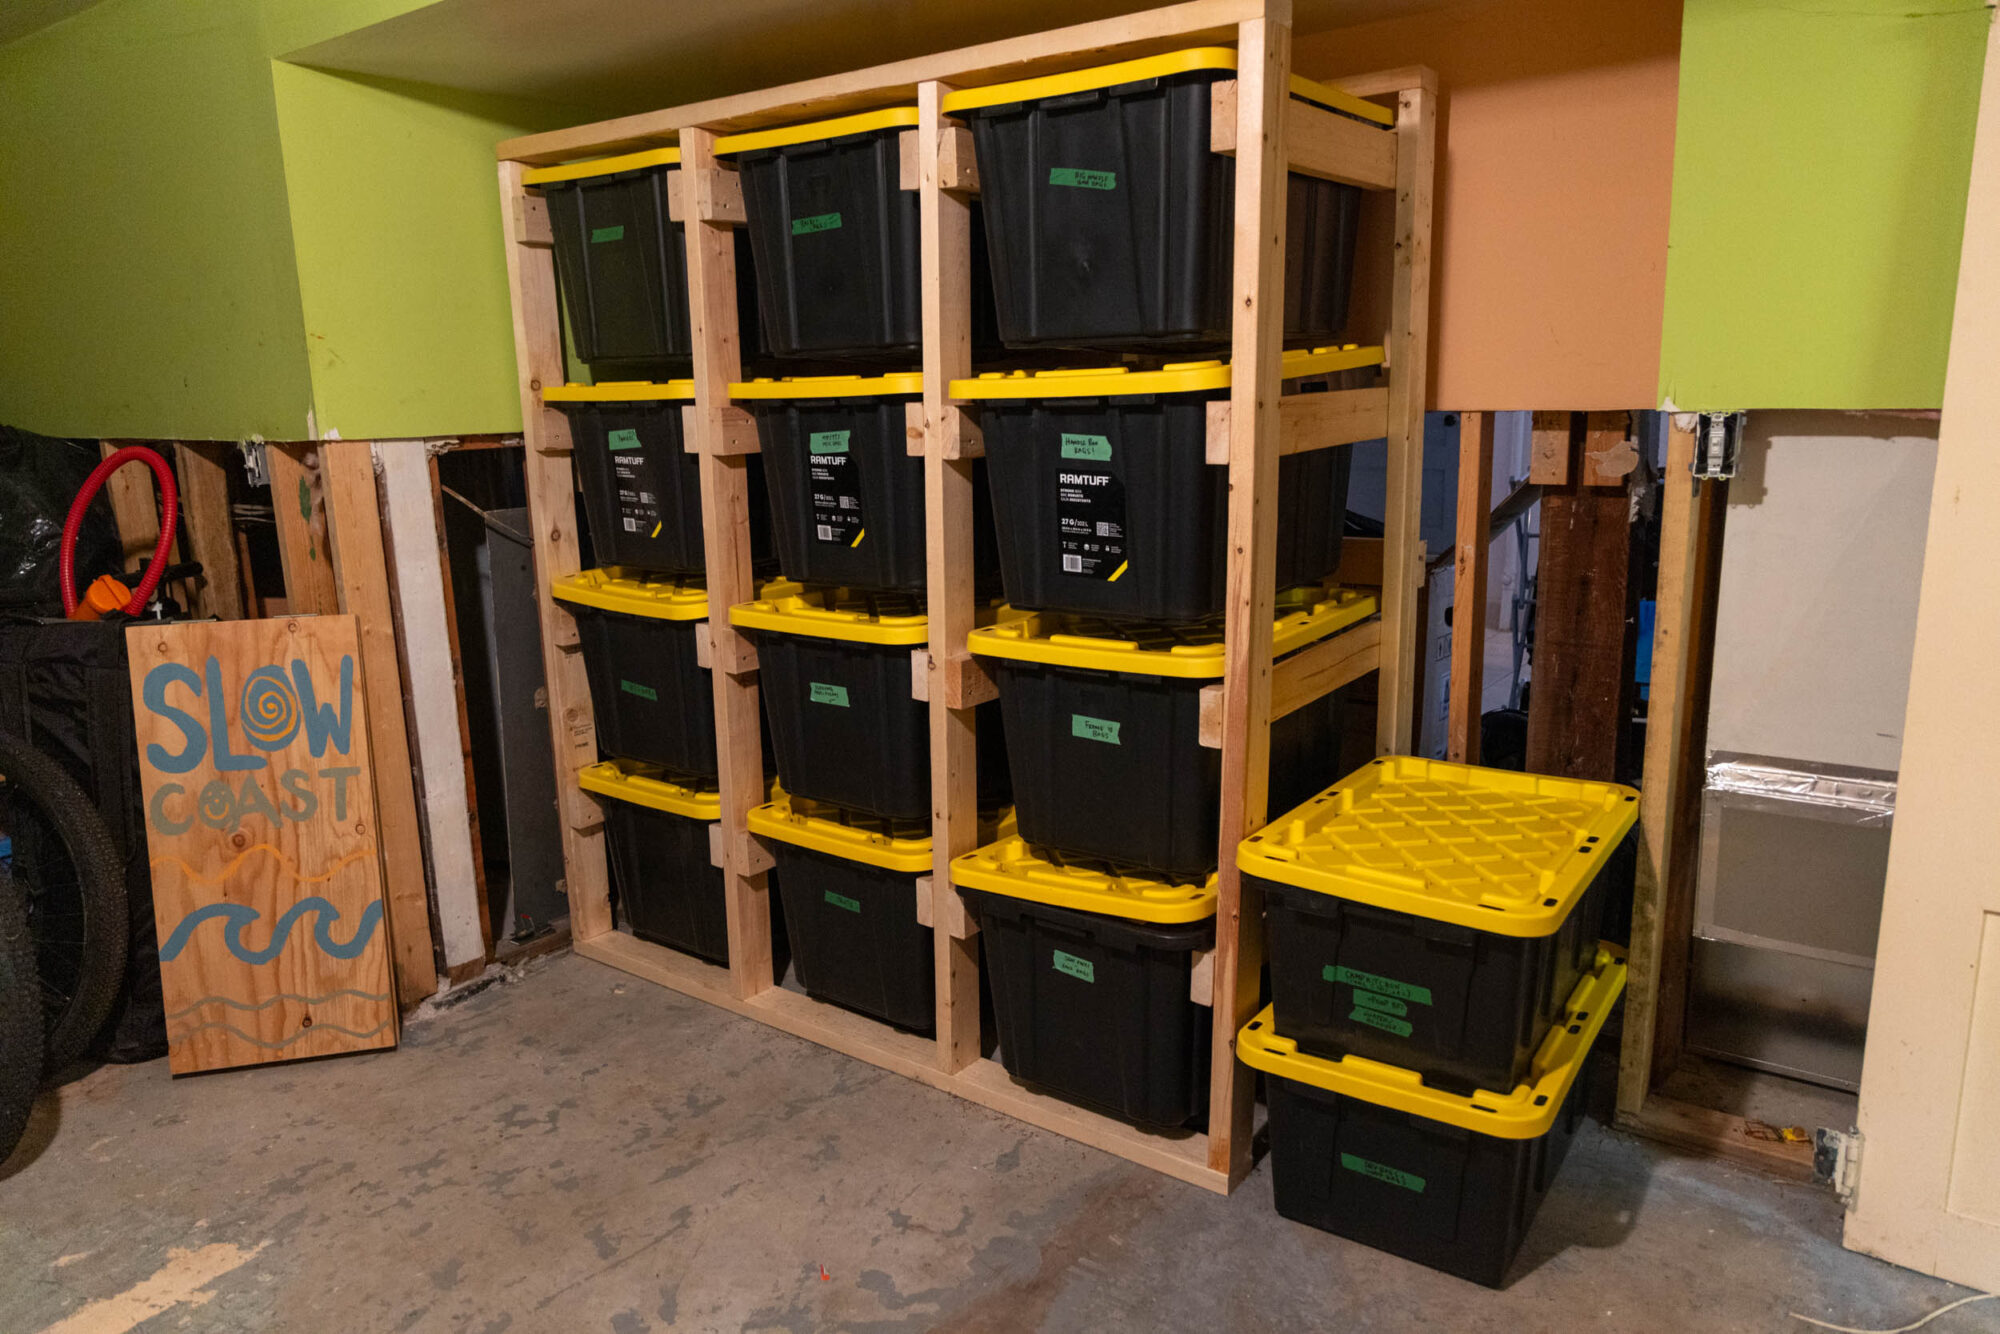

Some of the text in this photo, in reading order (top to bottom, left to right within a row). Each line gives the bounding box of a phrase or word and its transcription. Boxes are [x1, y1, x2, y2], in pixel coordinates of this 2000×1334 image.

[1065, 437, 1086, 446] HANDLE
[614, 455, 644, 466] RAMTUFF
[810, 455, 847, 466] RAMTUFF
[1060, 473, 1109, 487] RAMTUFF
[143, 655, 353, 774] SLOW
[149, 766, 361, 836] COAST
